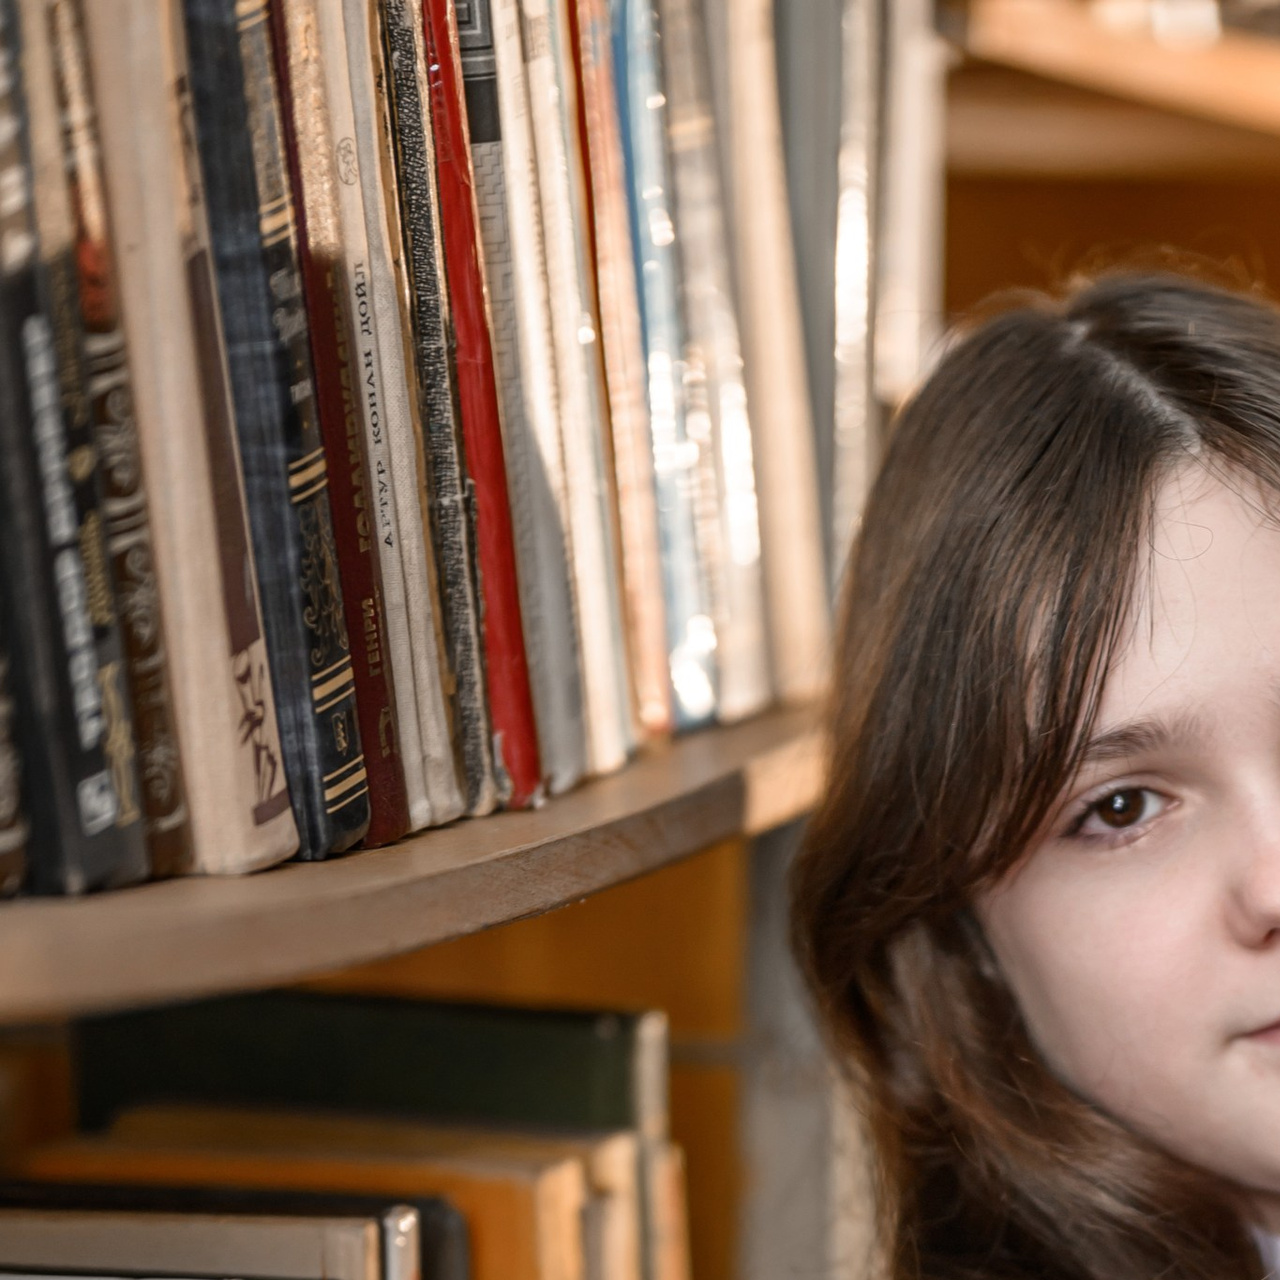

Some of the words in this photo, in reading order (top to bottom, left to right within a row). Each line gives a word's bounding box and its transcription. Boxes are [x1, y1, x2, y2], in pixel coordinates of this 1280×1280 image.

[353, 261, 372, 338] ДОЙЛ
[363, 349, 383, 446] КОНАН
[371, 460, 393, 548] АРТУР
